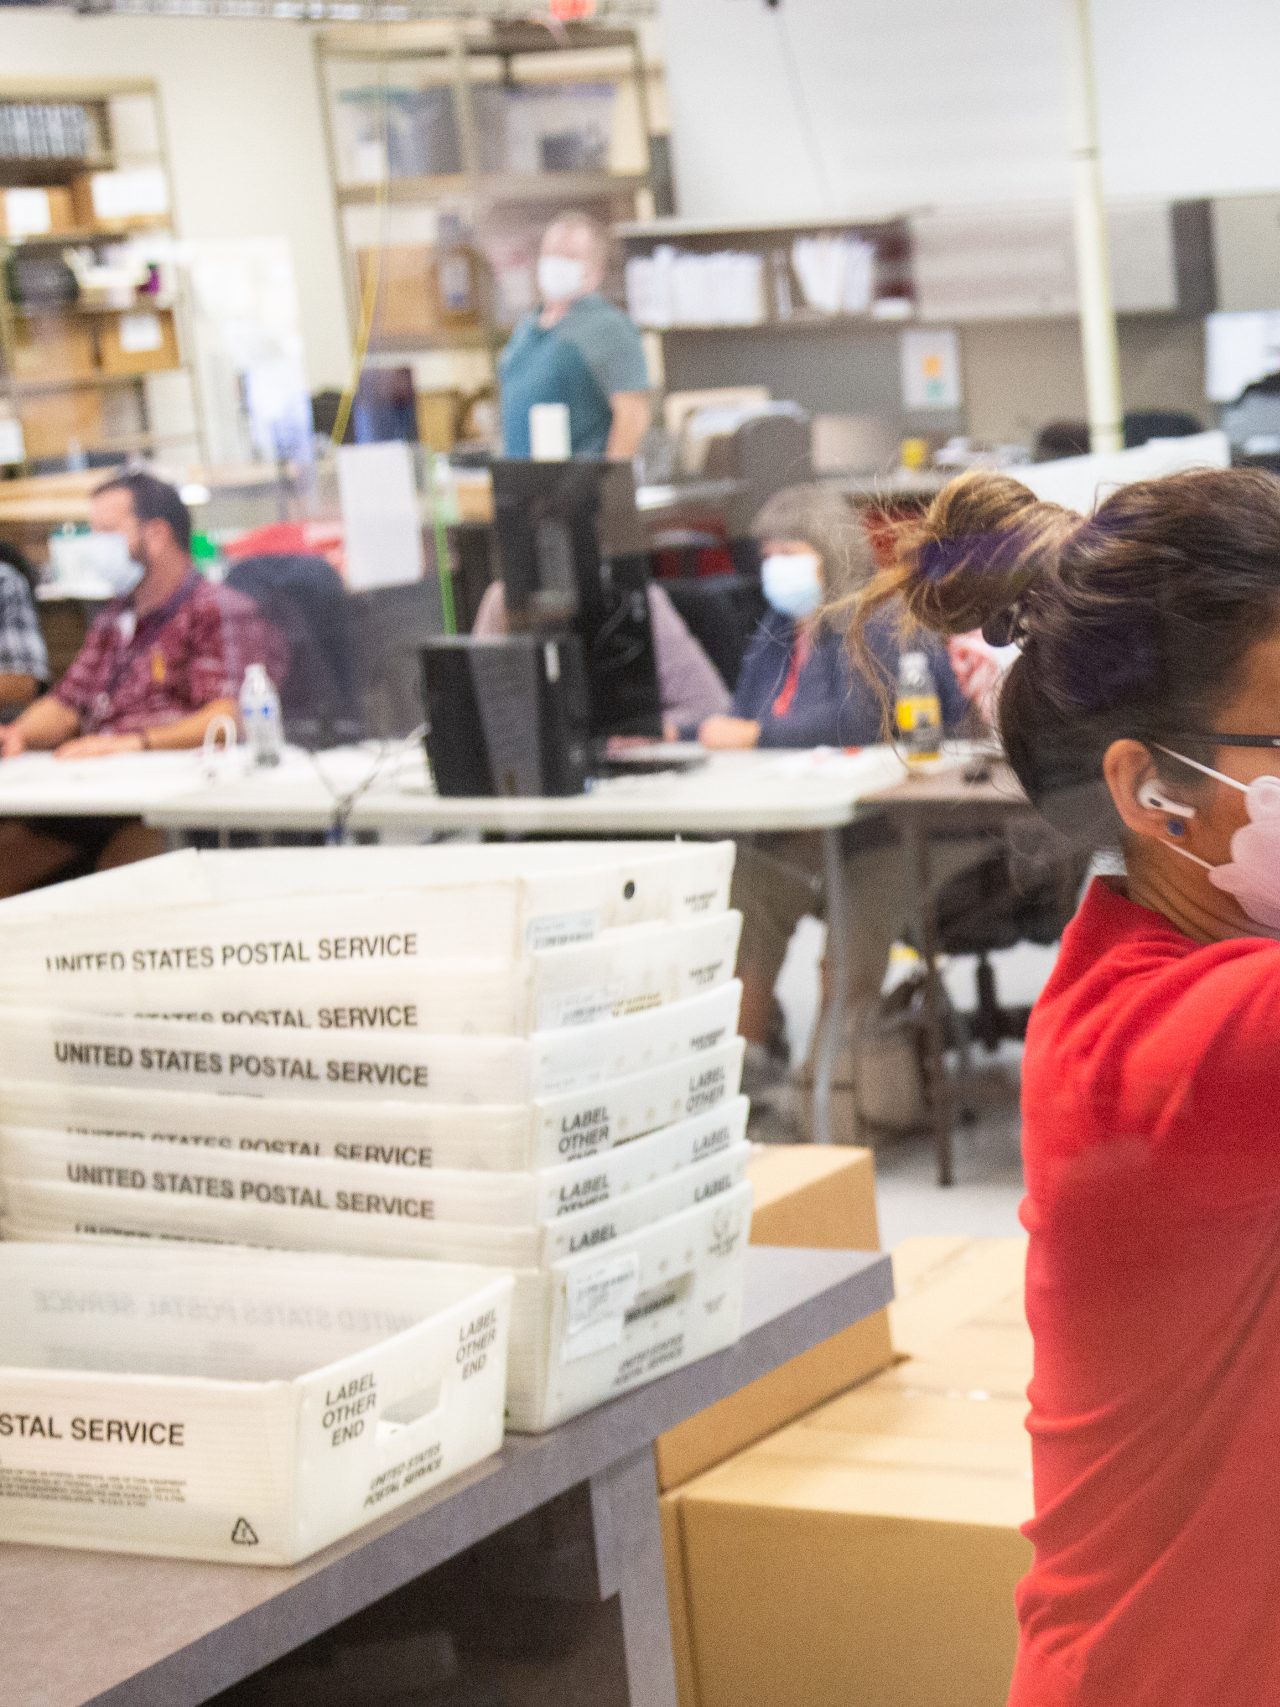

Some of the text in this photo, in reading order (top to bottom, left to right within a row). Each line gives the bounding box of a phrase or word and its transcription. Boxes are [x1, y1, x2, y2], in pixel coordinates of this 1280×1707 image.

[131, 946, 213, 971] STATES
[220, 940, 309, 966] POSTAL
[316, 933, 417, 961] SERVICE
[316, 1005, 417, 1028] SERVICE
[55, 1042, 428, 1087] UNITED STATES POSTAL SERVICE
[688, 1066, 725, 1092] LABEL
[685, 1085, 724, 1113] OTHER
[561, 1106, 610, 1133] LABEL
[558, 1125, 609, 1154] OTHER
[692, 1126, 729, 1155] LABEL
[333, 1143, 432, 1168] SERVICE
[66, 1164, 434, 1219] UNITED STATES POSTAL SERVICE
[559, 1174, 609, 1202] LABEL
[693, 1174, 731, 1203] LABEL
[568, 1223, 616, 1253] LABEL
[458, 1308, 497, 1343] LABEL
[455, 1328, 497, 1363] OTHER
[461, 1353, 487, 1381] END
[325, 1373, 377, 1407] LABEL
[321, 1393, 377, 1429] OTHER
[71, 1416, 185, 1447] SERVICE
[331, 1419, 365, 1447] END
